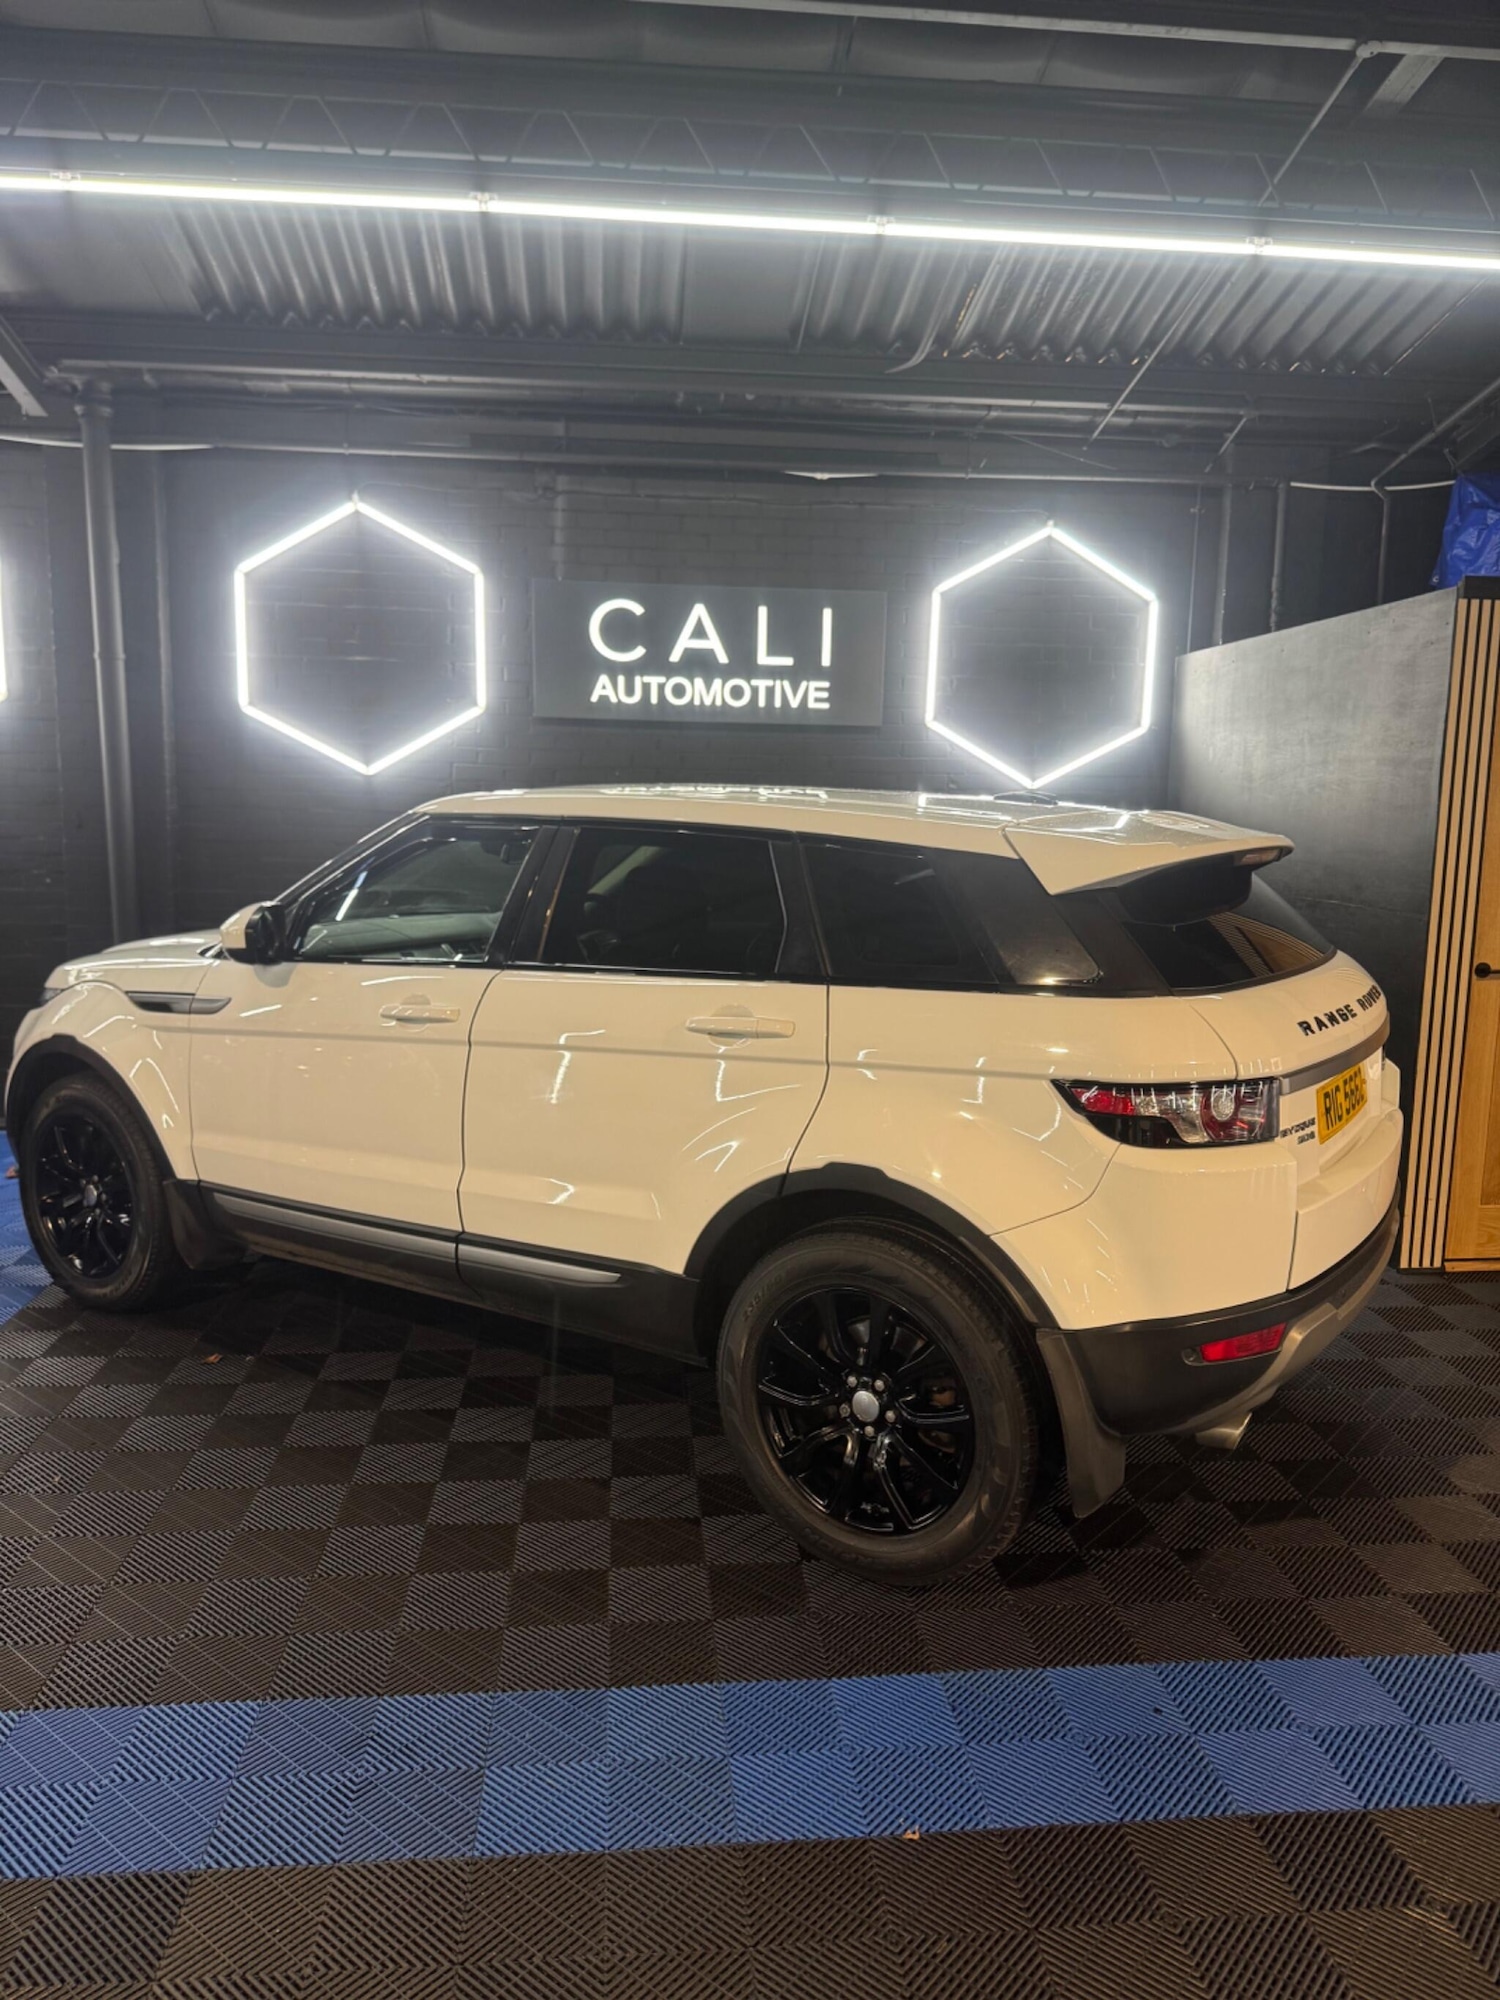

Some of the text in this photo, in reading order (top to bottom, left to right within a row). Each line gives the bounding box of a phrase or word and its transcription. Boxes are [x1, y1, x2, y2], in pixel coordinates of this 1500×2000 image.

[588, 597, 833, 667] CALI
[589, 673, 831, 710] AUTOMOTIVE
[1297, 984, 1382, 1036] RANGE ROVER
[1323, 1082, 1343, 1131] RIG
